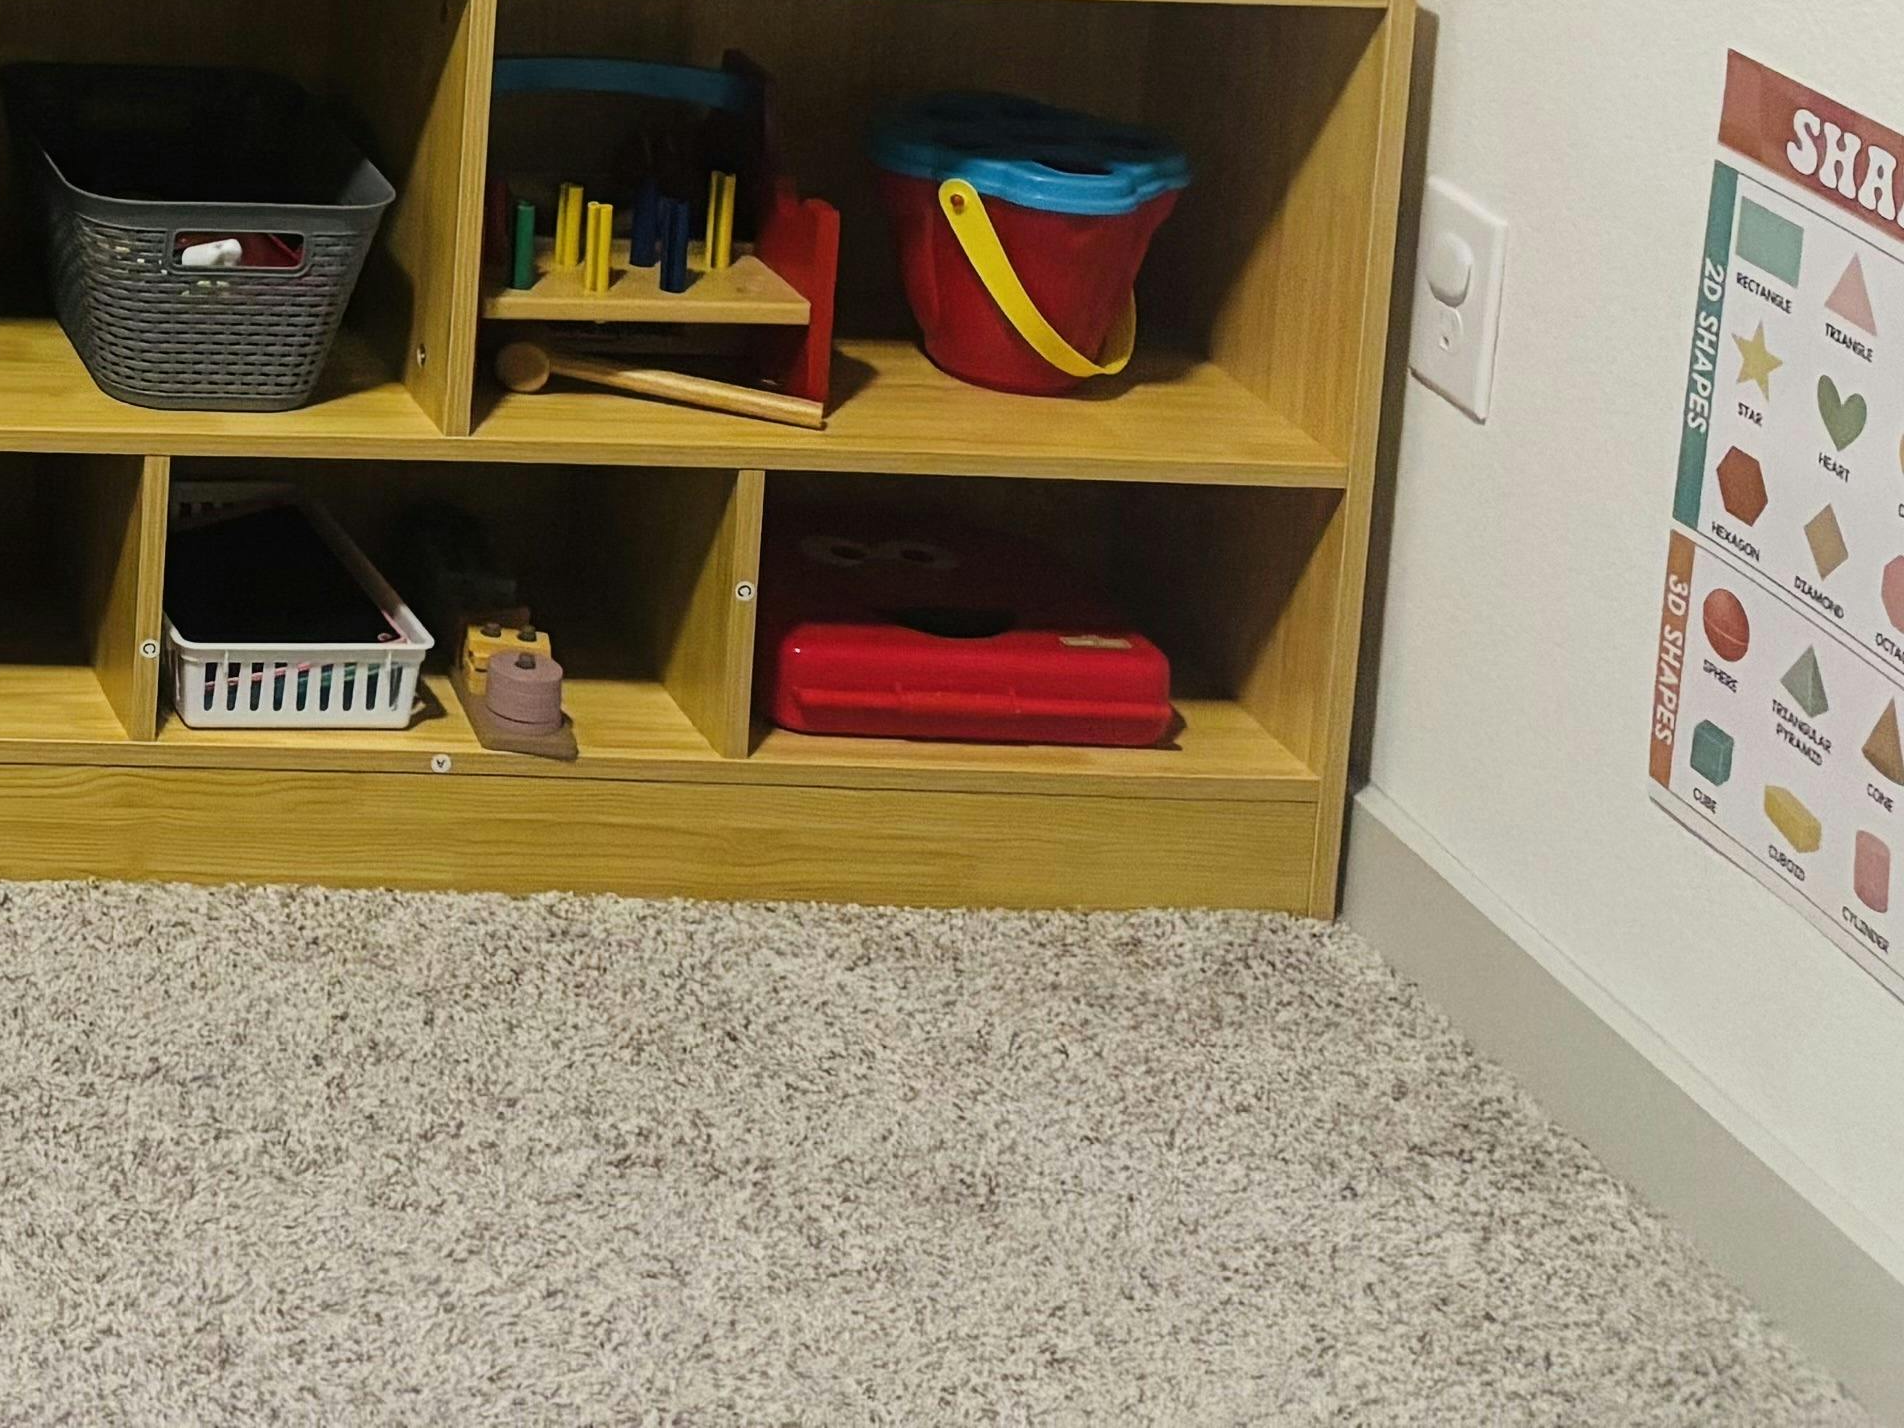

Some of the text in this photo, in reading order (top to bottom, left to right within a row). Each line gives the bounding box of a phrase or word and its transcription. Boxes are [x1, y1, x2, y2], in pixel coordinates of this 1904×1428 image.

[1687, 258, 1724, 432] 2D SHAPES
[1736, 272, 1792, 314] RECTANGLE
[1654, 574, 1688, 746] 3D SHAPES
